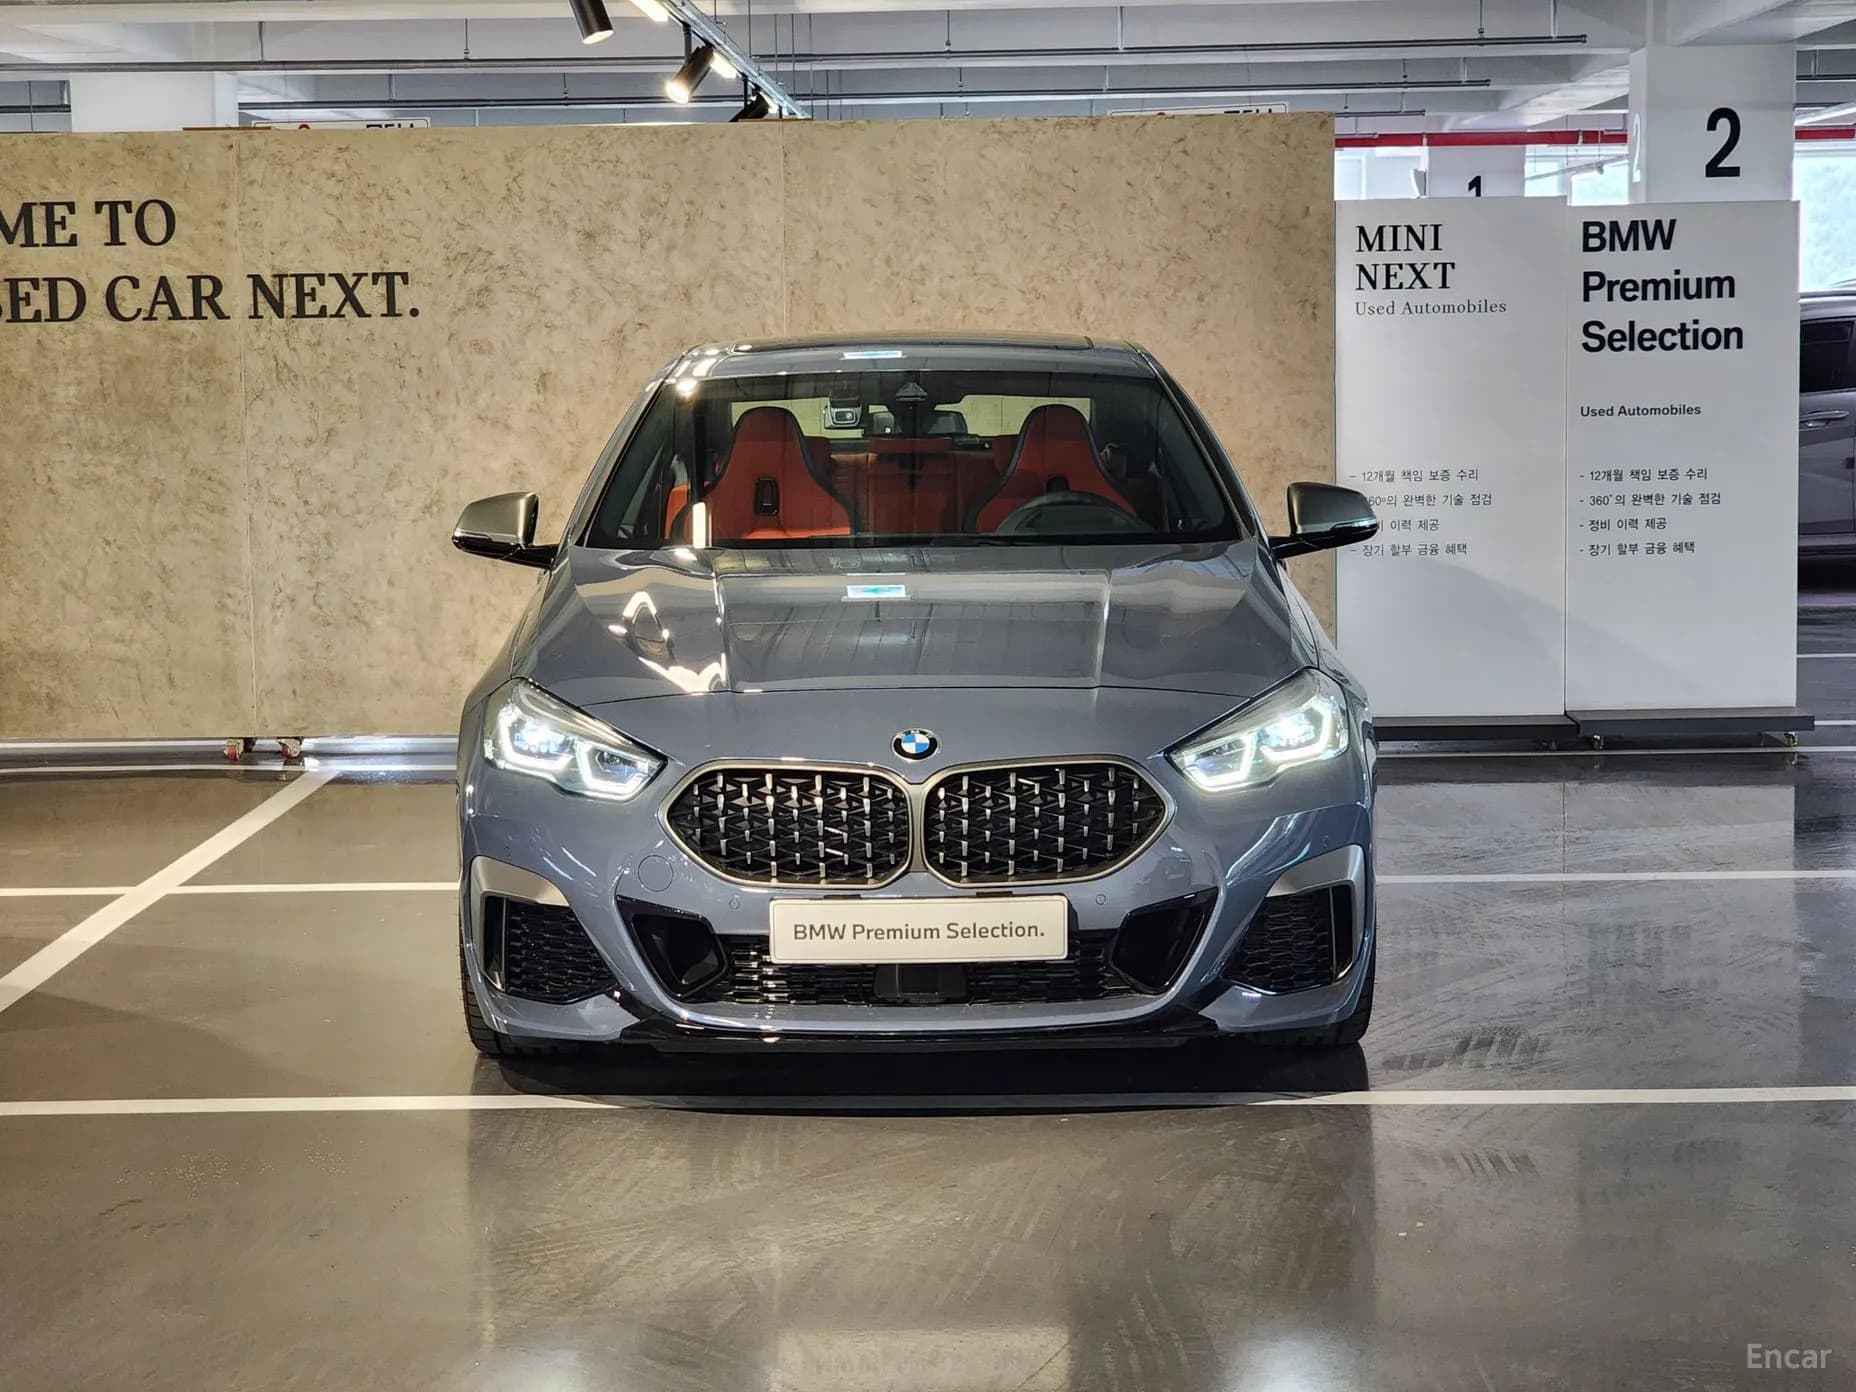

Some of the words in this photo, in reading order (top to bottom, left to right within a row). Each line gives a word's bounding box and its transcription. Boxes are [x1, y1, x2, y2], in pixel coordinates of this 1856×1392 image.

[1705, 107, 1741, 178] 2
[95, 199, 176, 247] TO
[1355, 224, 1443, 252] MINI
[1582, 218, 1677, 252] BMW
[1355, 262, 1456, 290] NEXT
[1582, 269, 1736, 302] Premium
[0, 276, 87, 323] ED
[105, 274, 230, 322] CAR
[247, 271, 420, 320] NEXT.
[1355, 301, 1395, 315] Used
[1402, 299, 1507, 314] Automobiles
[1581, 319, 1744, 352] Selection
[1580, 406, 1614, 417] Used
[1617, 404, 1702, 416] Automobiles
[1362, 470, 1395, 483] 12개월
[1401, 470, 1423, 482] 책임
[1429, 470, 1450, 481] 보증
[1456, 469, 1479, 480] 수리
[1590, 470, 1623, 482] 12개월
[1630, 469, 1651, 481] 책임
[1657, 469, 1679, 480] 보증
[1685, 468, 1707, 480] 수리
[1403, 495, 1436, 506] 완벽한
[1442, 494, 1464, 506] 기술
[1471, 494, 1492, 505] 점검
[1632, 494, 1665, 506] 완벽한
[1672, 493, 1693, 505] 기술
[1699, 493, 1721, 505] 점검
[1390, 520, 1411, 531] 이력
[1418, 520, 1440, 531] 제공
[1589, 520, 1611, 531] 정비
[1617, 519, 1639, 530] 이력
[1645, 517, 1667, 529] 제공
[1363, 545, 1384, 557] 장기
[1390, 544, 1412, 556] 할부
[1418, 544, 1439, 556] 금융
[1445, 544, 1467, 555] 혜택
[1589, 544, 1611, 556] 장기
[1617, 544, 1639, 555] 할부
[1645, 542, 1667, 555] 금융
[1673, 542, 1695, 553] 혜택
[794, 924, 846, 941] BMW
[852, 922, 940, 940] Premium
[946, 921, 1045, 939] Selection.
